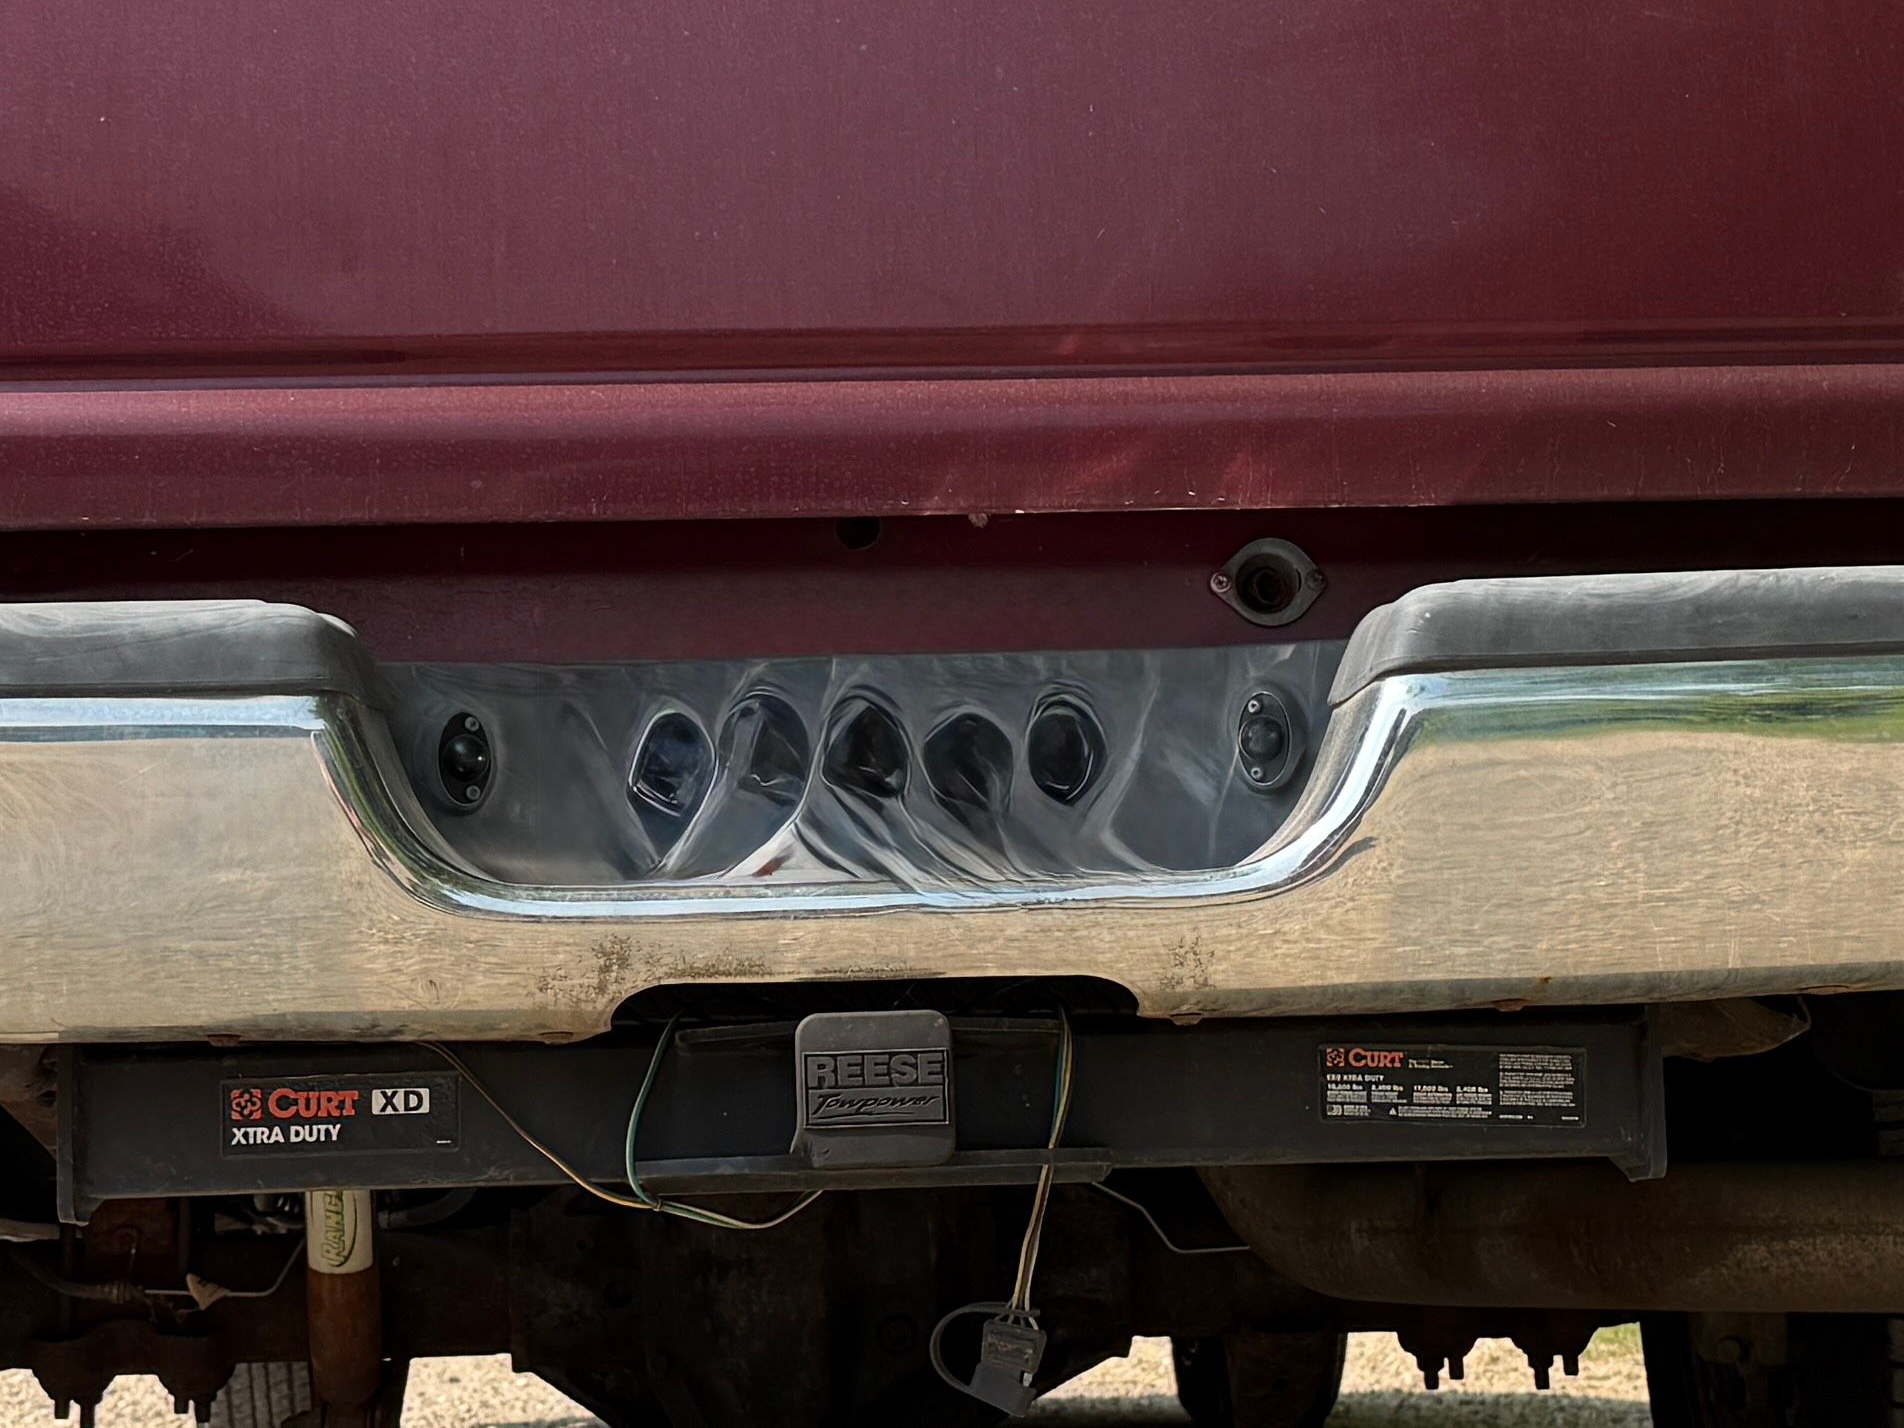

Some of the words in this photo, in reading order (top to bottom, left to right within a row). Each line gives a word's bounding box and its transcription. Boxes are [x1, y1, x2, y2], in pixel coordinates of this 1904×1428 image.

[806, 1052, 944, 1089] REESE
[1349, 1047, 1404, 1068] CURT
[268, 1087, 359, 1118] CURT
[379, 1089, 424, 1113] XD
[812, 1093, 940, 1116] Towpower
[231, 1125, 285, 1146] XTRA
[289, 1123, 342, 1143] DUTY
[321, 1190, 346, 1264] RANC
